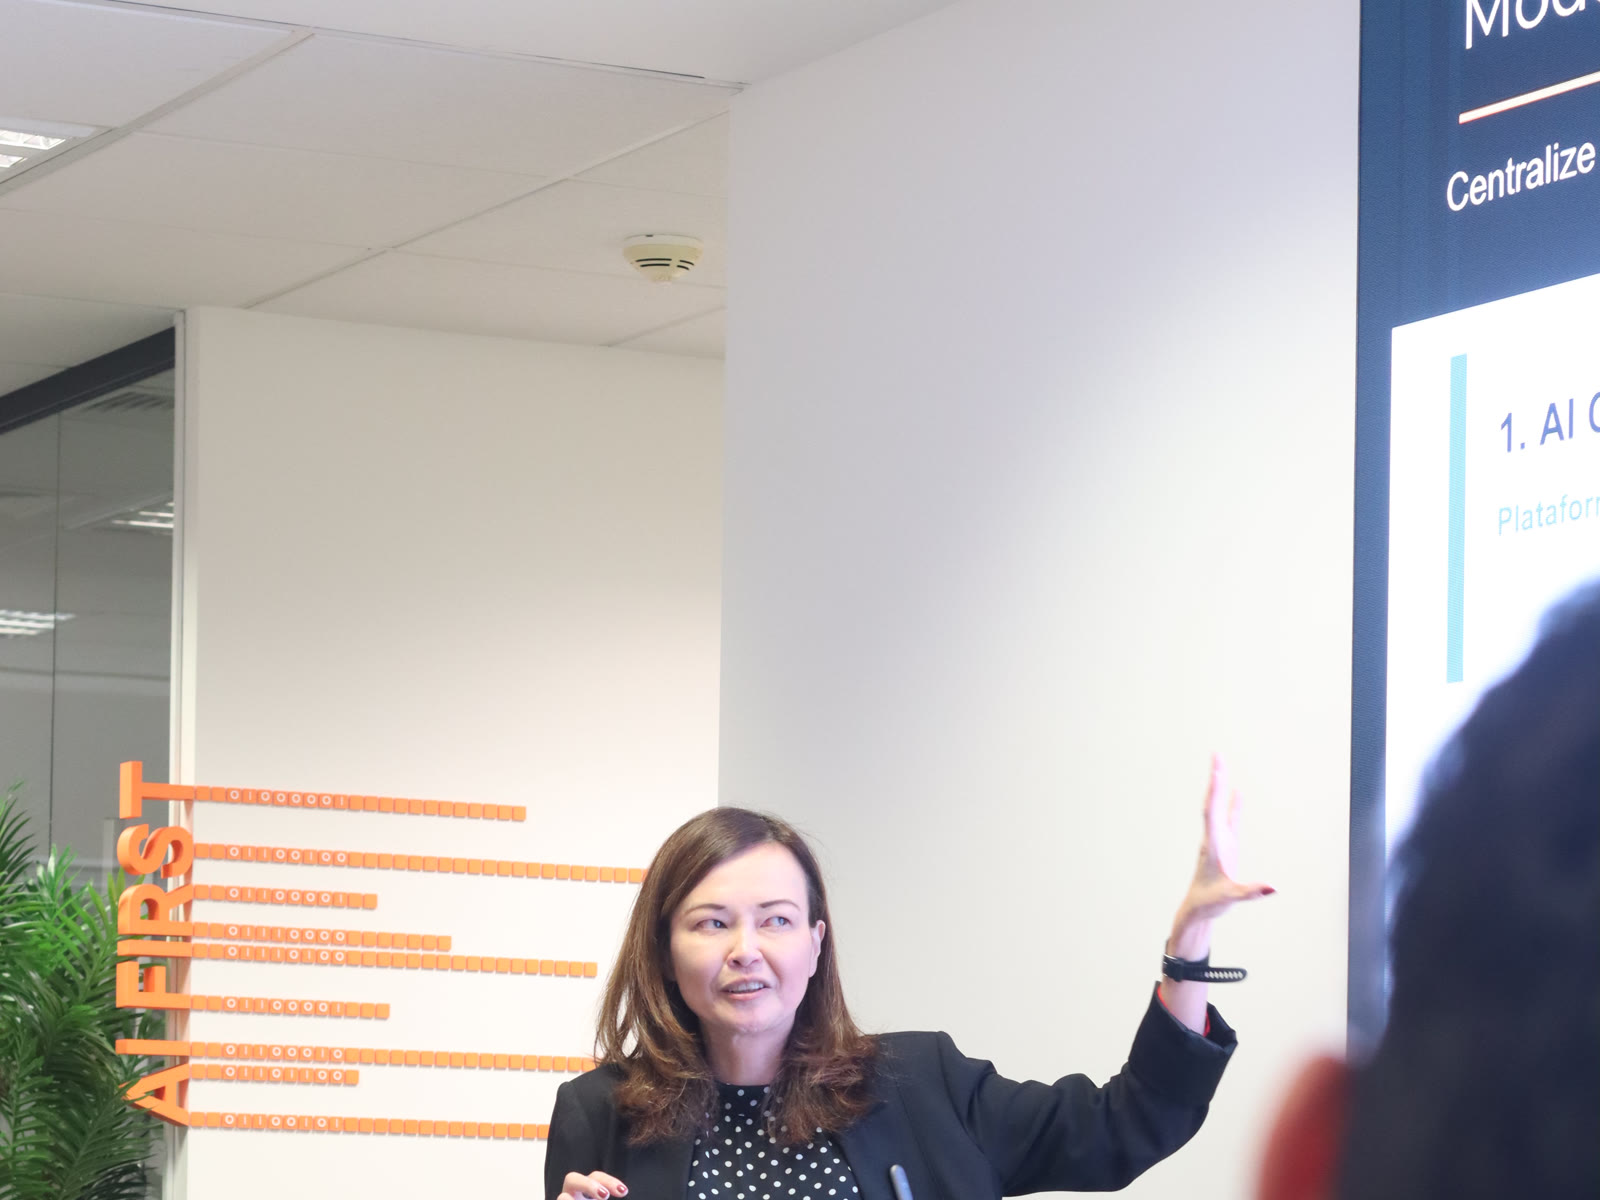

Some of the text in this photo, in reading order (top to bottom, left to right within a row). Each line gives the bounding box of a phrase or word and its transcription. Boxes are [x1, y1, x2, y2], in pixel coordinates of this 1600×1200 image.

[1447, 142, 1596, 211] Centralize
[1500, 412, 1526, 453] 1.
[1539, 398, 1574, 446] AI
[115, 761, 195, 1127] AI FIRST
